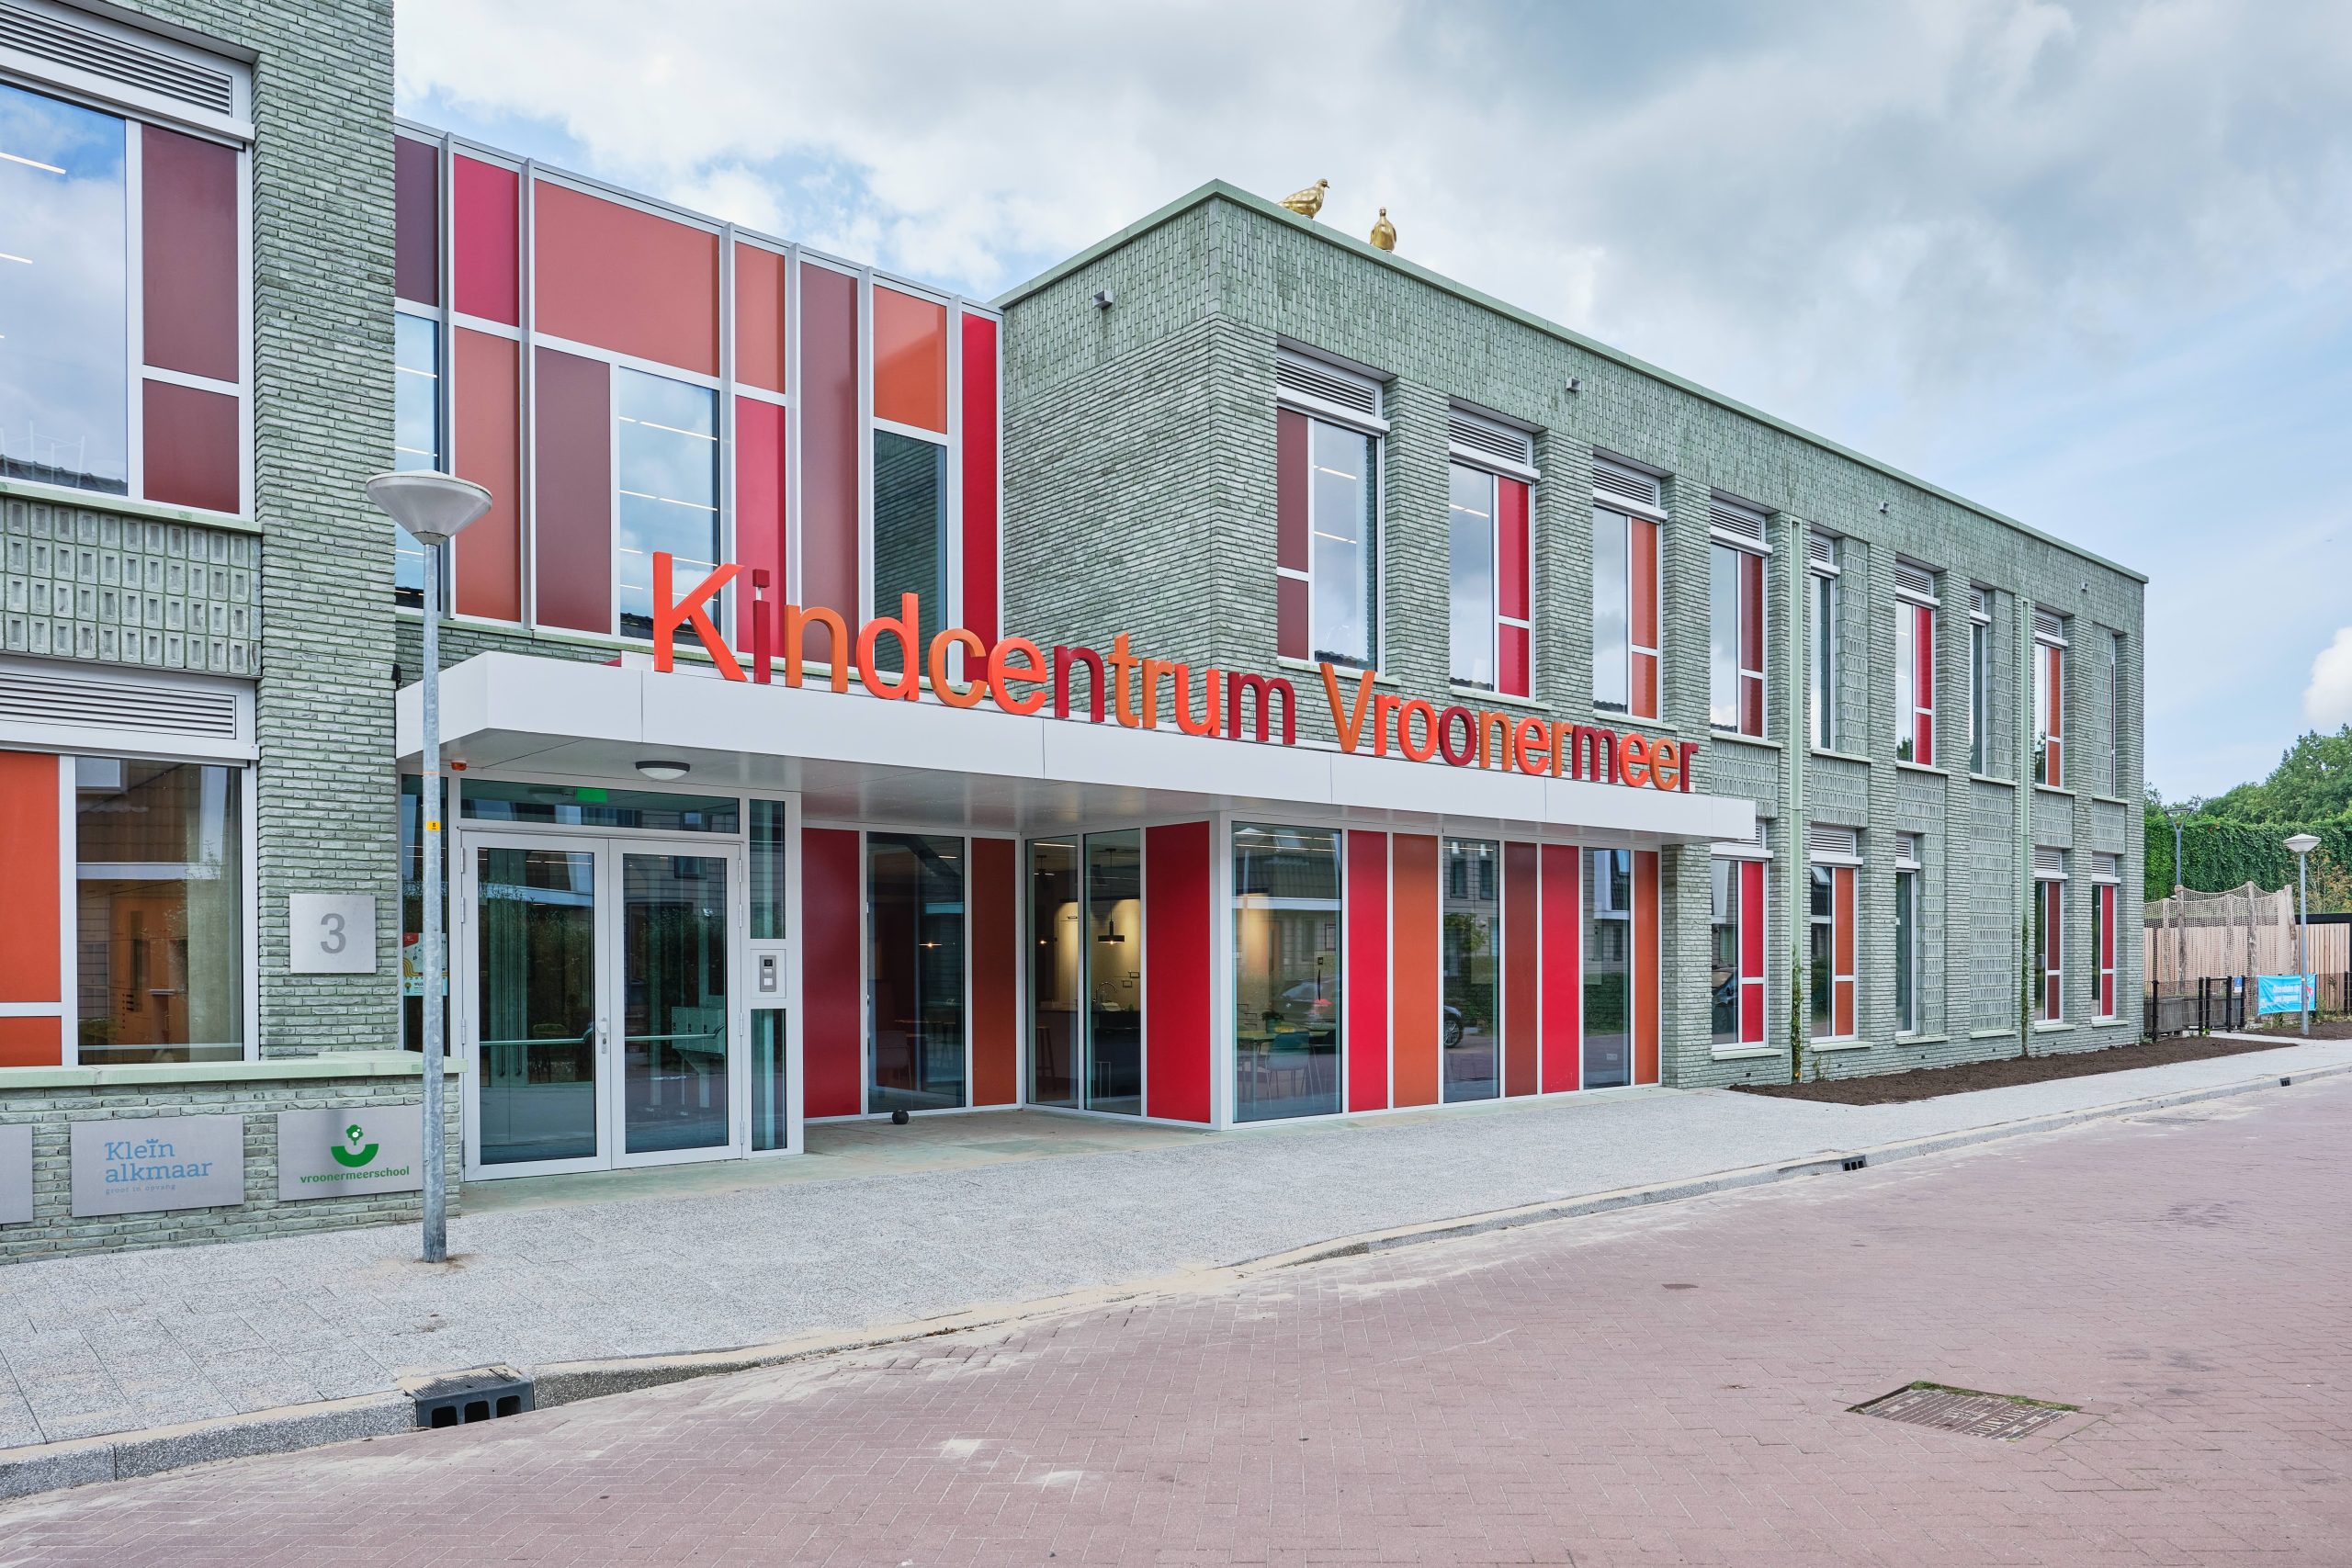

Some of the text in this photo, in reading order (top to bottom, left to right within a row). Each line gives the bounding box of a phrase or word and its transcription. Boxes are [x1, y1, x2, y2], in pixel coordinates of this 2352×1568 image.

[653, 551, 1699, 793] Kindcentrum Vroonermeer
[321, 913, 346, 954] 3
[105, 1162, 213, 1183] alkmaar
[300, 1166, 410, 1183] vroonermeerschool
